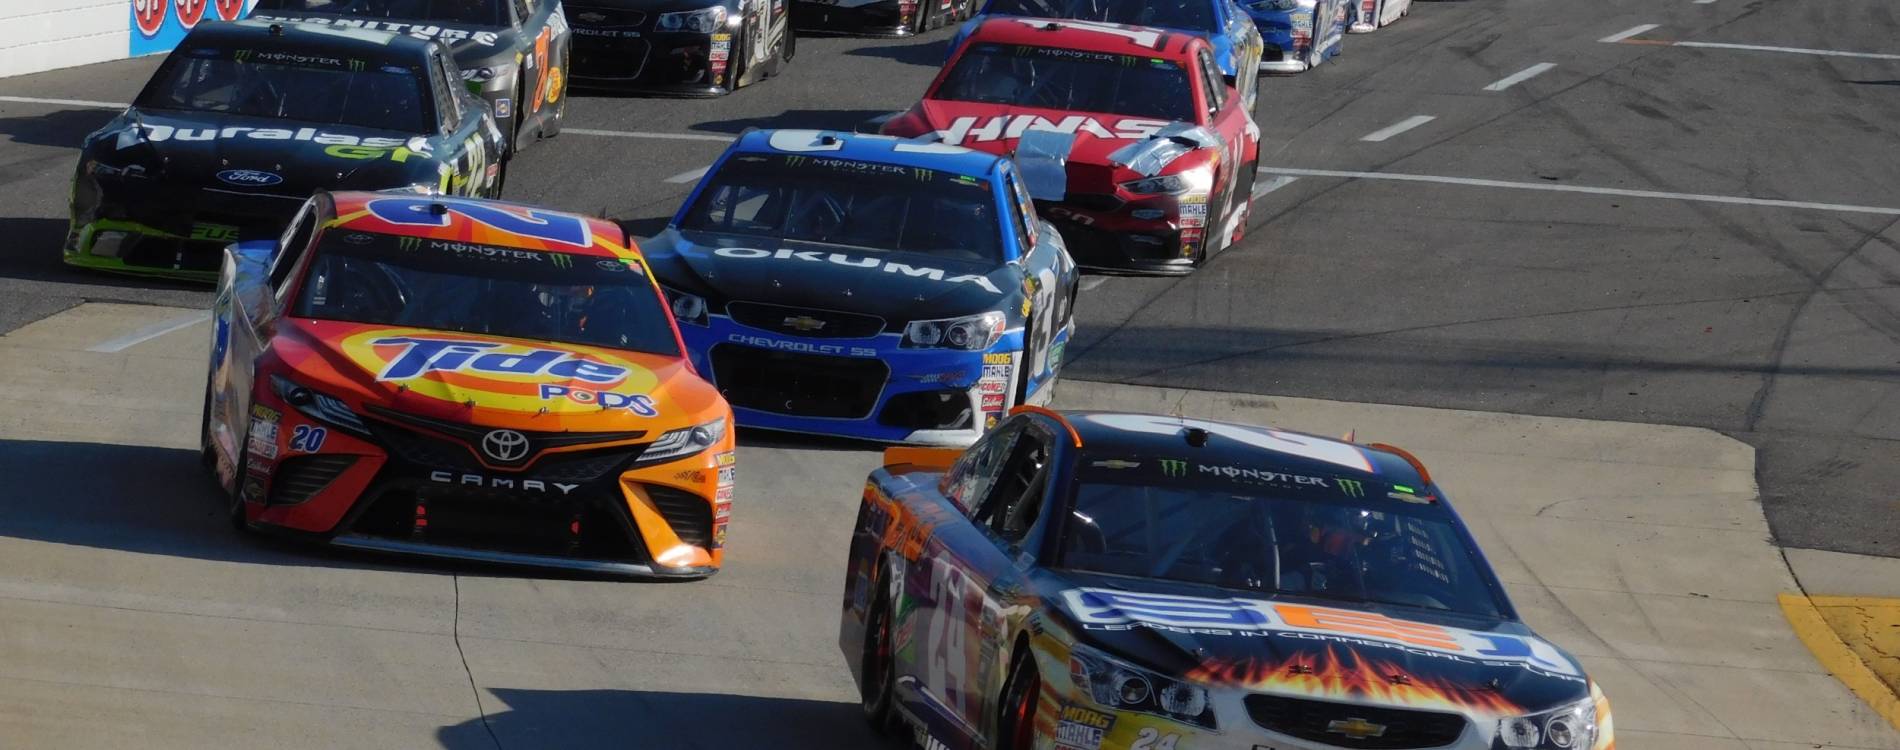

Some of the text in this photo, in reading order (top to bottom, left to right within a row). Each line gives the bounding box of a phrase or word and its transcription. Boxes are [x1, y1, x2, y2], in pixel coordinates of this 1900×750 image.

[257, 51, 342, 66] MONSTER
[1038, 49, 1115, 63] MONSTER
[811, 158, 907, 175] MONSTER
[1180, 204, 1207, 215] MAHLE
[430, 241, 543, 262] MONSTER
[714, 248, 1003, 295] OKUMA
[728, 333, 877, 357] CHEVROLET SS
[369, 336, 633, 383] Tide
[538, 383, 659, 417] PODS
[289, 425, 327, 454] 20
[430, 471, 580, 495] CAMRY
[1198, 464, 1330, 488] MONSTER
[1083, 623, 1233, 637] LEADERS
[1277, 631, 1475, 664] COMMERCIAL
[1130, 726, 1182, 750] 24
